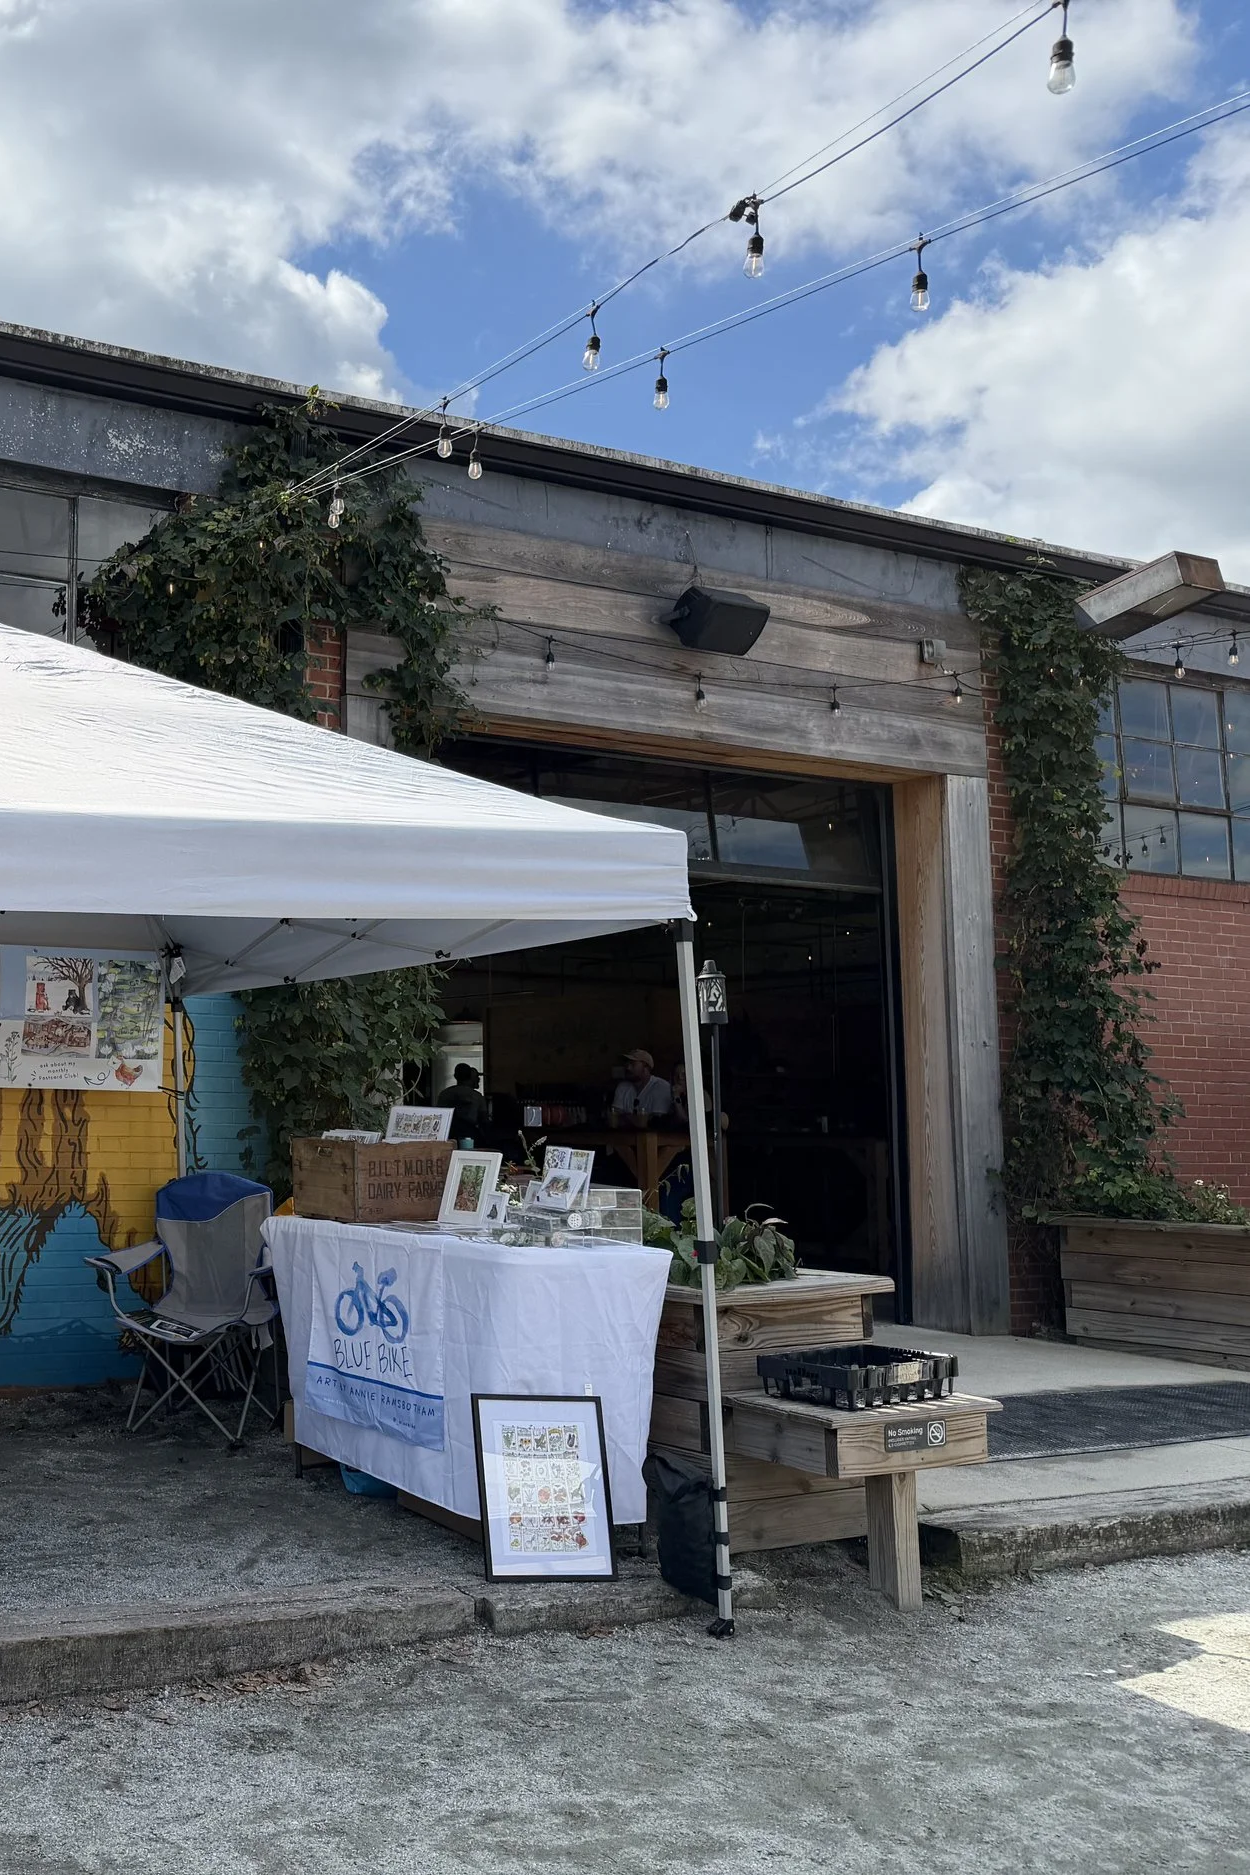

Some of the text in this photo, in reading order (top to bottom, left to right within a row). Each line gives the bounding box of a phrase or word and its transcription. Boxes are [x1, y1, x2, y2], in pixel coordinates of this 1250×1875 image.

[368, 1159, 443, 1178] BILTMORE
[368, 1182, 401, 1200] DAIRY
[334, 1339, 412, 1378] BLUE BIKE
[316, 1376, 337, 1387] ART
[350, 1386, 376, 1400] ANNIE
[380, 1394, 435, 1416] RAMSBOTHAM
[898, 1427, 924, 1436] Smoking
